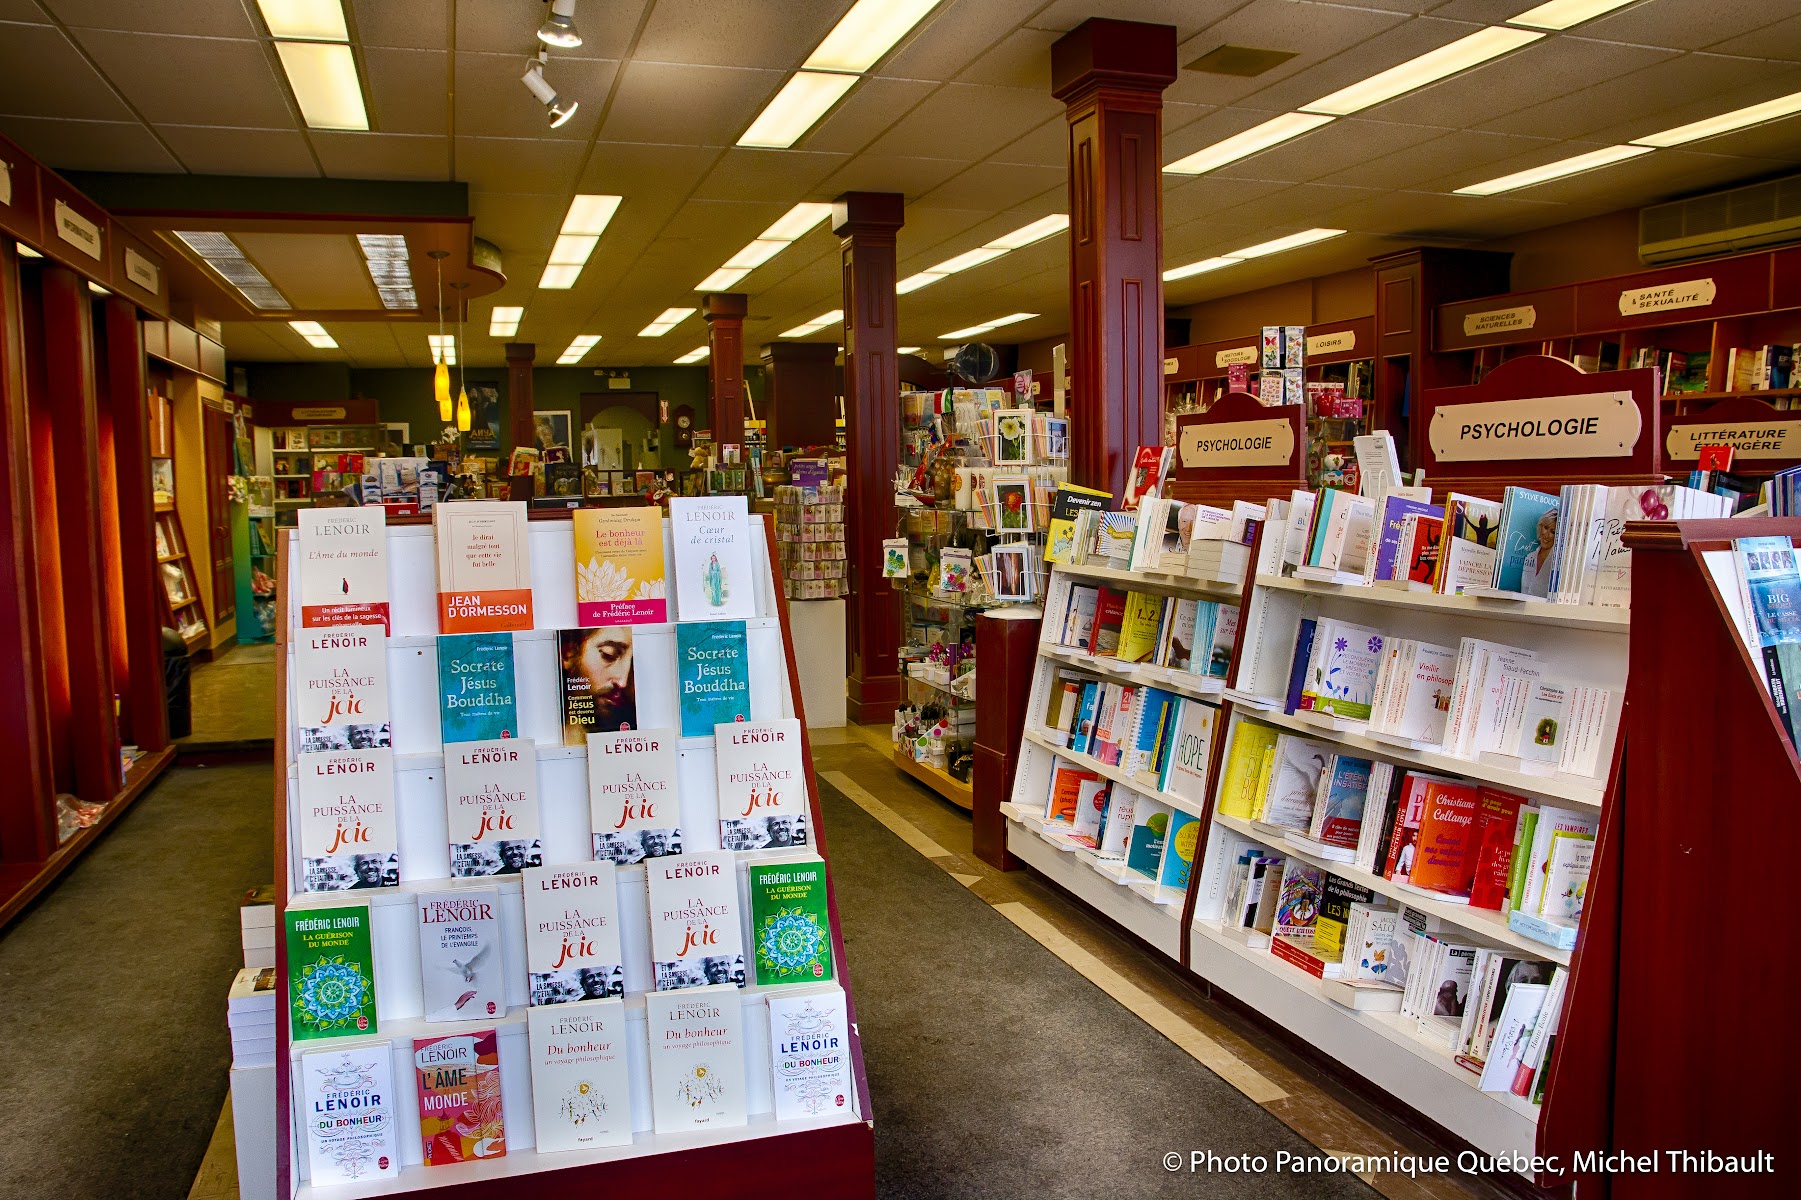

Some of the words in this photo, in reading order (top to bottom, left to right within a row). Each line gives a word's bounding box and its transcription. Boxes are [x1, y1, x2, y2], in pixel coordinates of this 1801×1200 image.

[1639, 289, 1675, 300] SANTÉ
[1640, 294, 1698, 308] SEXUALITÉ
[1480, 313, 1515, 322] SCIENCES
[1475, 319, 1522, 330] NATURELLES
[1316, 339, 1342, 348] LOISIRS
[1460, 417, 1599, 440] PSYCHOLOGIE
[1691, 430, 1787, 440] LITTÉRATURE
[1197, 437, 1272, 452] PSYCHOLOGIE
[1067, 496, 1089, 506] Devenir
[1520, 491, 1539, 502] SYLVIE
[1540, 496, 1559, 507] BOUCH
[687, 511, 735, 522] LENOIR
[315, 525, 370, 536] LENOIR
[699, 526, 724, 534] Cœur
[615, 539, 632, 548] déjà
[691, 536, 702, 544] de
[705, 535, 734, 544] cristal
[309, 551, 334, 560] L'Âme
[335, 551, 347, 559] du
[350, 550, 379, 558] monde
[1510, 555, 1535, 567] parfait
[449, 596, 480, 606] JEAN
[1767, 594, 1789, 603] BIG
[361, 613, 381, 621] sagesse
[449, 605, 527, 618] D'ORMESSON
[1777, 610, 1797, 618] CASSE
[312, 638, 367, 649] LENOIR
[688, 648, 738, 660] Socrate
[451, 660, 504, 673] Socrate
[697, 664, 731, 679] Jésus
[1419, 662, 1439, 672] Vieillir
[309, 677, 375, 689] PUISSANCE
[461, 676, 497, 691] Jésus
[1427, 675, 1454, 685] philosop
[684, 680, 745, 693] Bouddha
[447, 695, 511, 708] Bouddha
[569, 701, 594, 709] Jésus
[321, 694, 365, 724] joie
[570, 715, 595, 724] Dieu
[733, 732, 784, 744] LENOIR
[606, 742, 659, 754] LENOIR
[1178, 731, 1205, 770] HOPE
[463, 752, 518, 764] LENOIR
[317, 763, 375, 775] LENOIR
[730, 770, 791, 782] PUISSANCE
[1339, 772, 1368, 782] L'ÉTERN
[602, 781, 666, 793] PUISSANCE
[1334, 780, 1368, 790] INSATISF
[460, 792, 526, 805] PUISSANCE
[1436, 794, 1475, 808] Christiane
[313, 804, 383, 817] PUISSANCE
[614, 799, 658, 828] joie
[1433, 809, 1472, 827] Collange
[472, 810, 517, 840] joie
[1564, 825, 1589, 833] VAMPIRES
[326, 822, 373, 853] joie
[666, 865, 720, 879] LENOIR
[760, 873, 791, 884] FRÉDÉRIC
[794, 872, 817, 882] LENOIR
[542, 876, 598, 890] LENOIR
[1338, 878, 1353, 888] Grands
[1354, 882, 1369, 893] Textes
[1340, 889, 1367, 902] philosophie
[430, 900, 480, 909] FRÉDÉRIC
[1327, 902, 1340, 915] LES
[423, 904, 493, 923] LENOIR
[663, 906, 728, 920] PUISSANCE
[296, 919, 330, 931] FRÉDÉRIC
[333, 917, 359, 929] LENOIR
[539, 917, 606, 932] PUISSANCE
[316, 931, 353, 940] GUÉRISON
[309, 940, 318, 948] DU
[321, 939, 348, 947] MONDE
[552, 937, 598, 969] joie
[670, 1007, 720, 1021] LENOIR
[551, 1022, 603, 1035] LENOIR
[666, 1030, 681, 1040] Du
[685, 1027, 727, 1038] bonheur
[792, 1033, 829, 1041] FRÉDÉRIC
[548, 1045, 564, 1055] Du
[567, 1041, 611, 1053] bonheur
[781, 1037, 838, 1053] LENOIR
[421, 1048, 466, 1063] LENOIR
[555, 1058, 574, 1066] voyage
[576, 1054, 615, 1064] philosophique
[784, 1061, 796, 1069] DU
[799, 1056, 839, 1067] BONHEUR
[422, 1068, 467, 1090] L'ÂME
[327, 1089, 370, 1099] FRÉDÉRIC
[315, 1095, 381, 1112] LENOIR
[424, 1092, 468, 1110] MONDE
[319, 1121, 333, 1129] DU
[336, 1115, 382, 1127] BONHEUR
